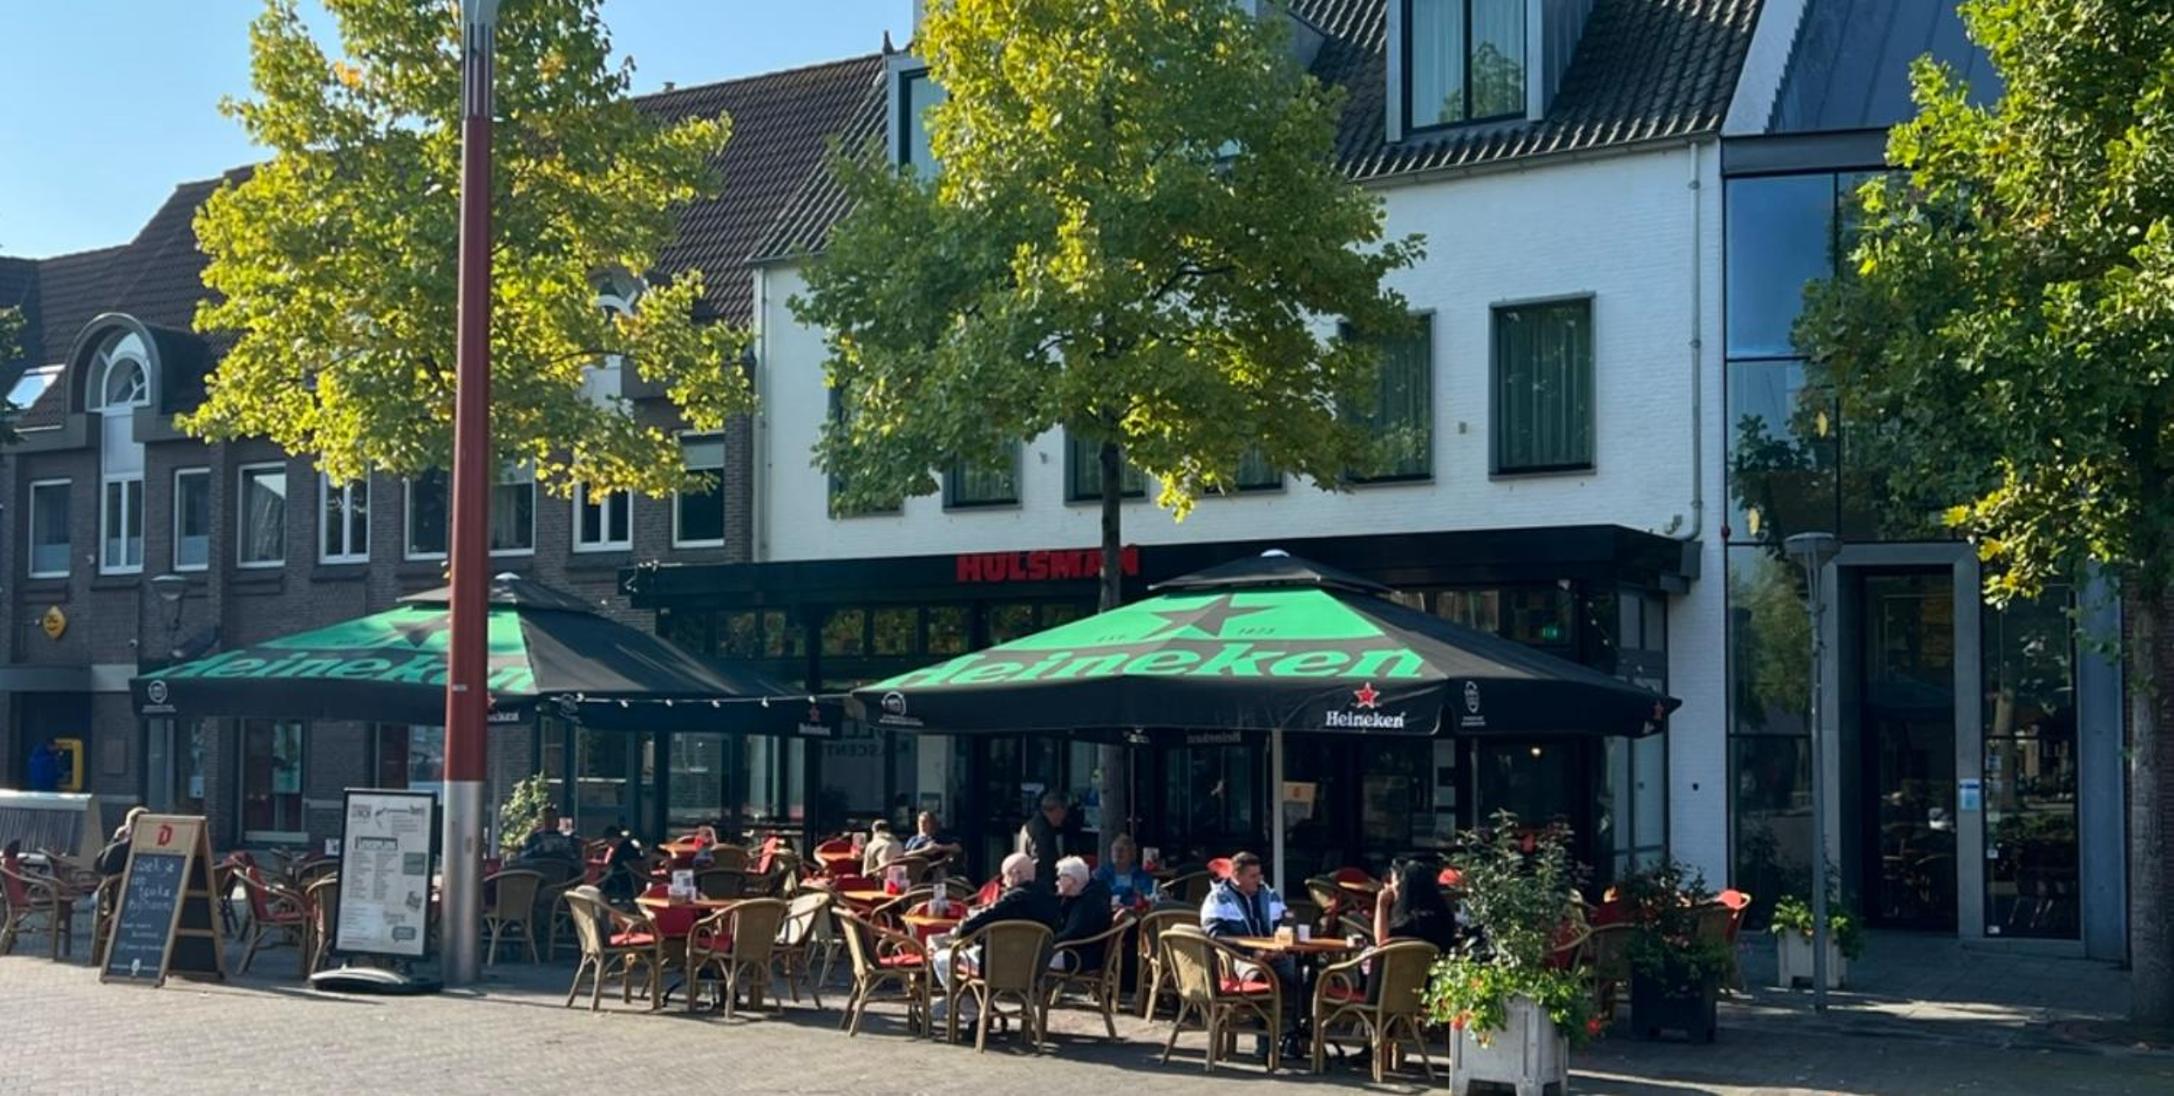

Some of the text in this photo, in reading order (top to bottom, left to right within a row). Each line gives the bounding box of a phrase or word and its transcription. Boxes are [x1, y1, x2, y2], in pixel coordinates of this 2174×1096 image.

[140, 650, 536, 692] Heinekn
[866, 643, 1425, 691] Heineken
[1326, 711, 1406, 728] Heineken
